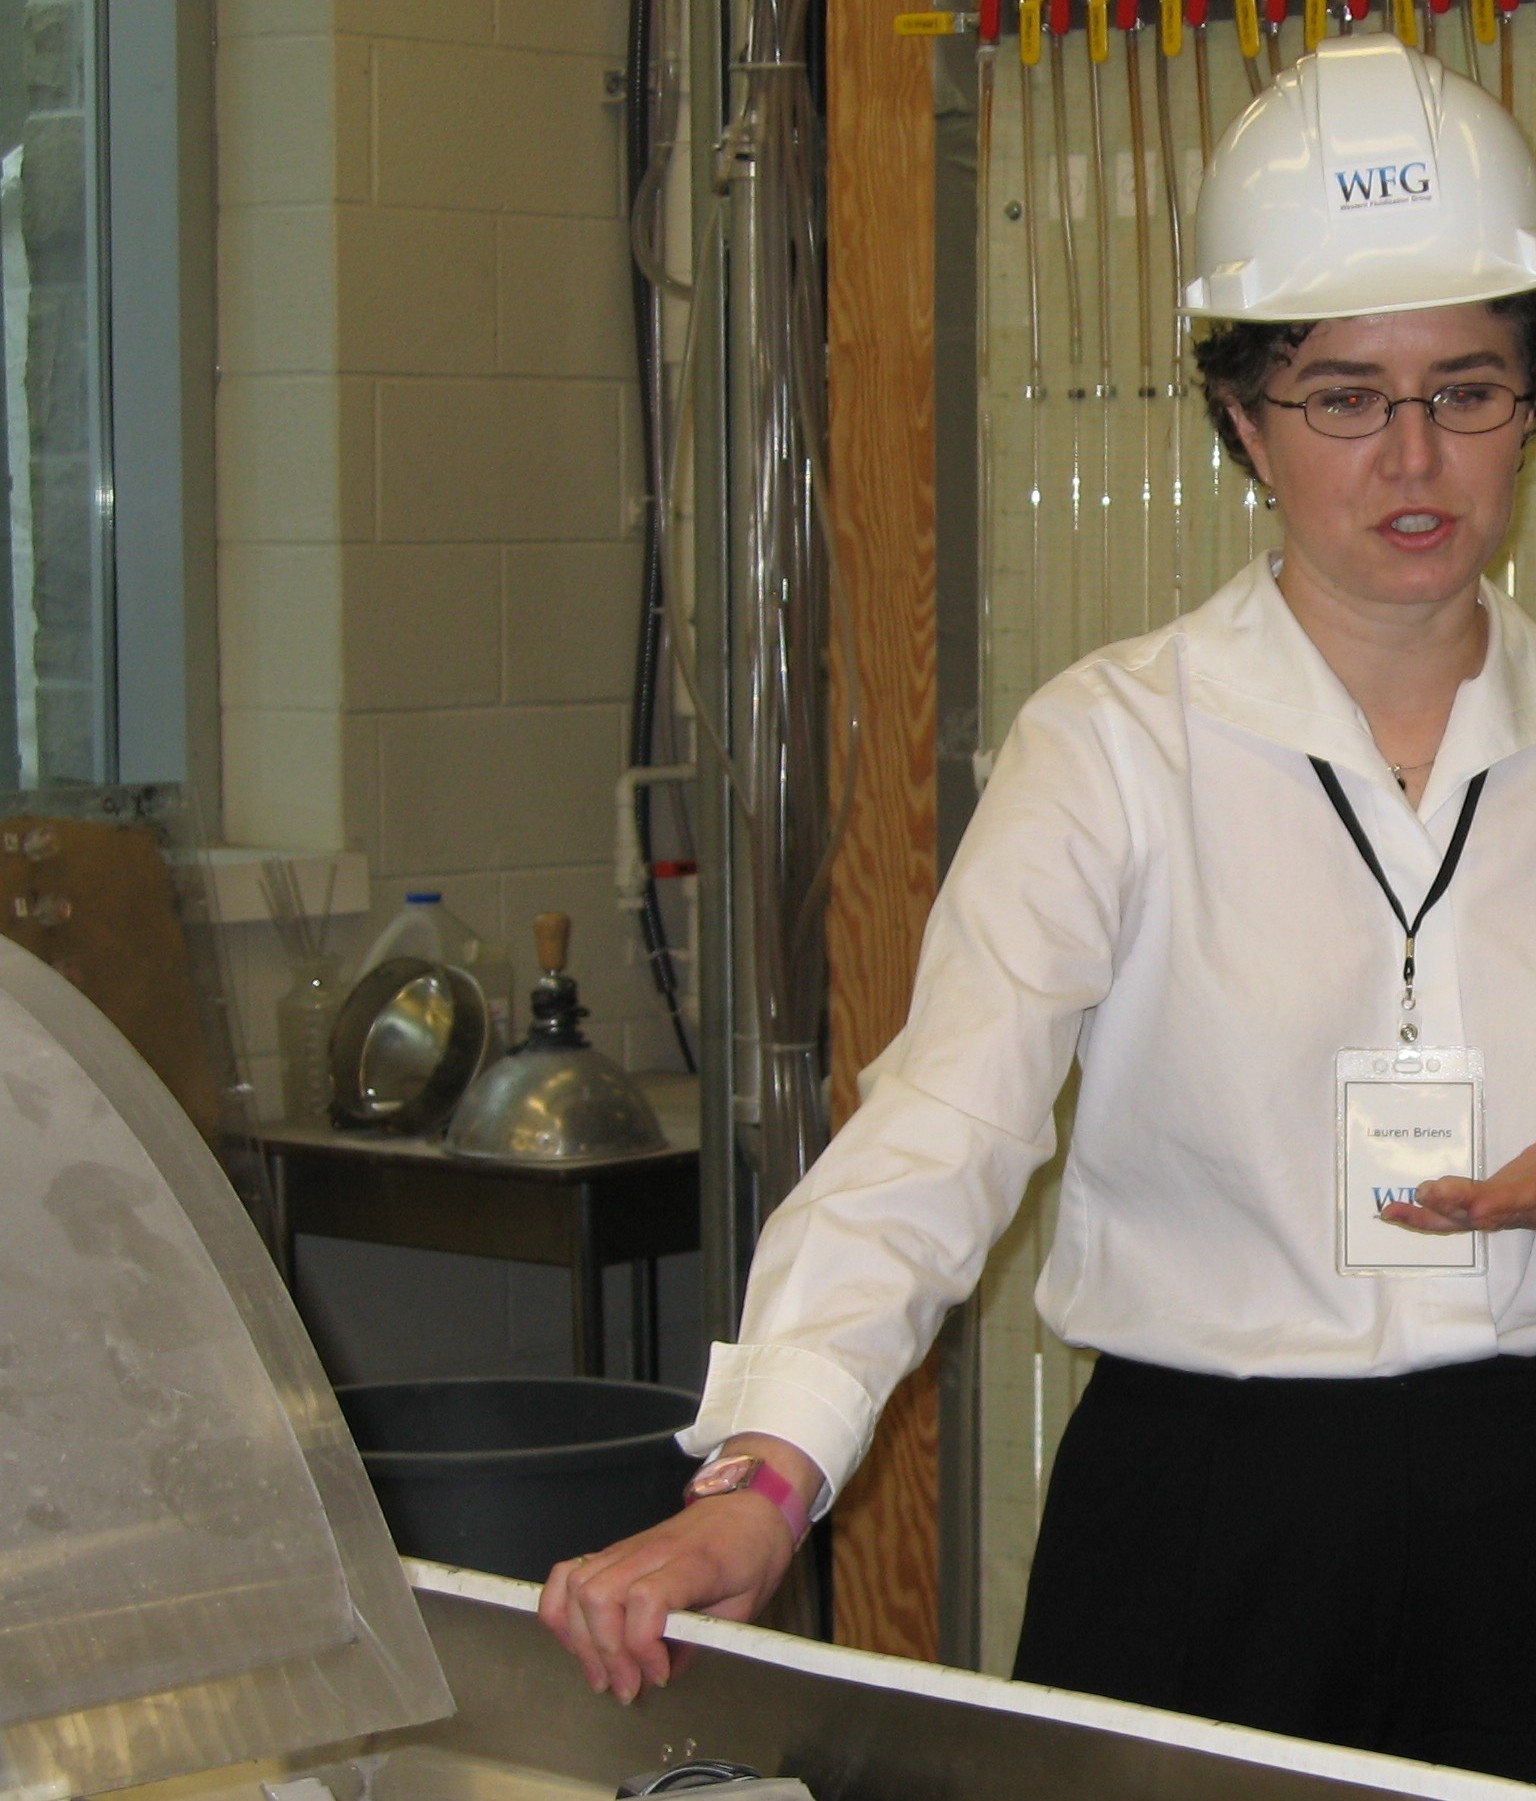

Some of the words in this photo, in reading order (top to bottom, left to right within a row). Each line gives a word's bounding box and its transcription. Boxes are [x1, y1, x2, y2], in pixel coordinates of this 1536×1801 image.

[1335, 161, 1430, 203] WFG
[1366, 1127, 1409, 1138] Lauren
[1413, 1126, 1453, 1138] Briens
[1371, 1186, 1420, 1213] WF
